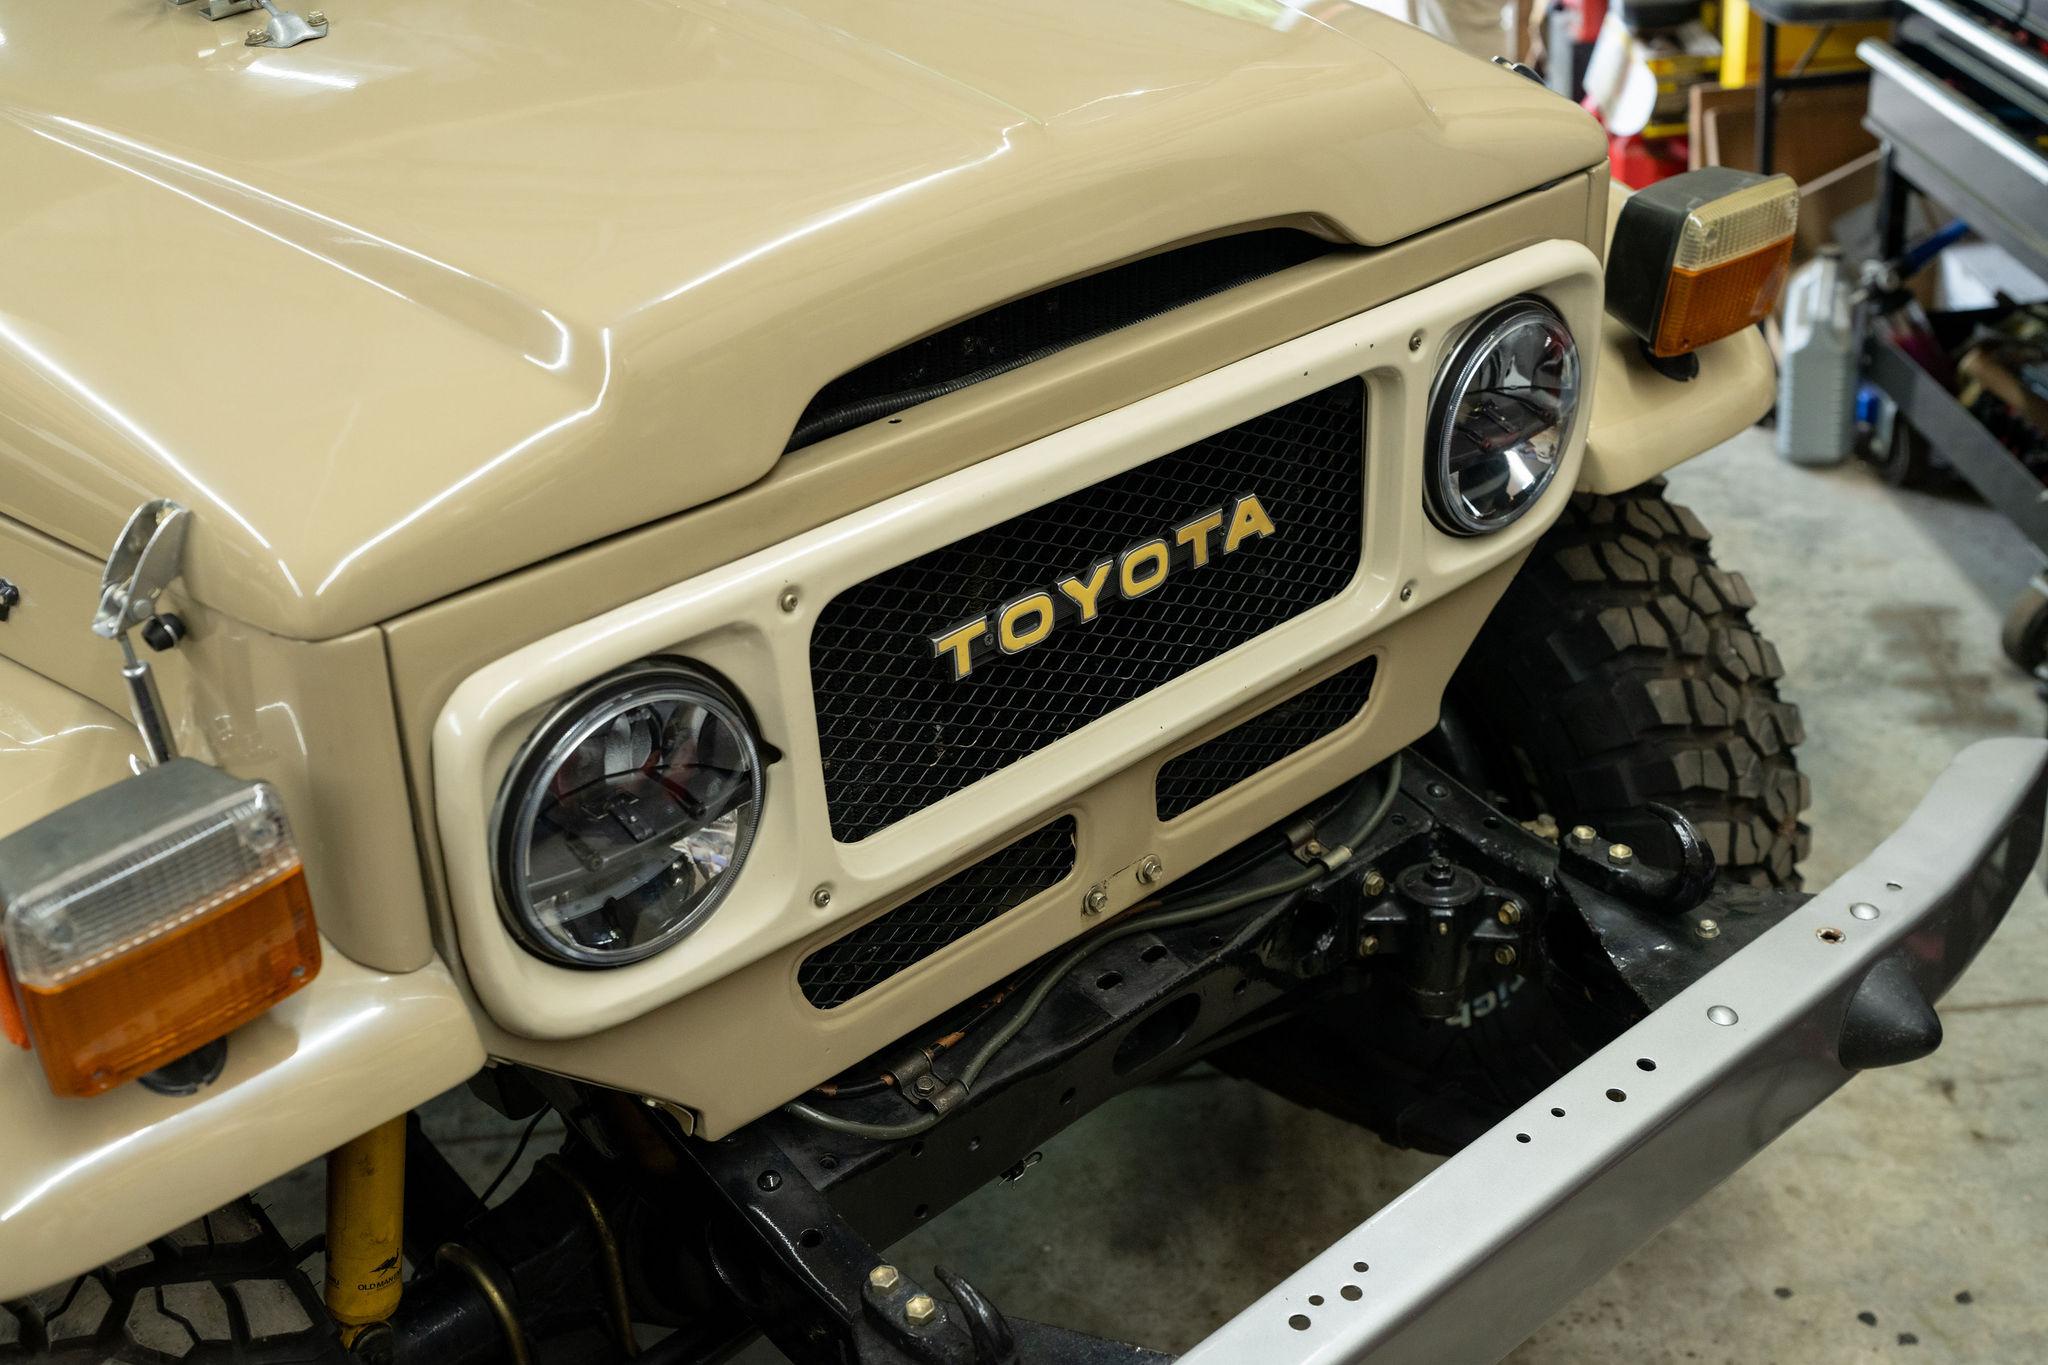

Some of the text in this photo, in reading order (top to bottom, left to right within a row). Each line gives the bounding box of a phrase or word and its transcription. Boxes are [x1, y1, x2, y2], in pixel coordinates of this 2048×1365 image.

[929, 491, 1276, 682] TOYOTA
[357, 1283, 376, 1291] OLD
[376, 1276, 394, 1289] MAN
